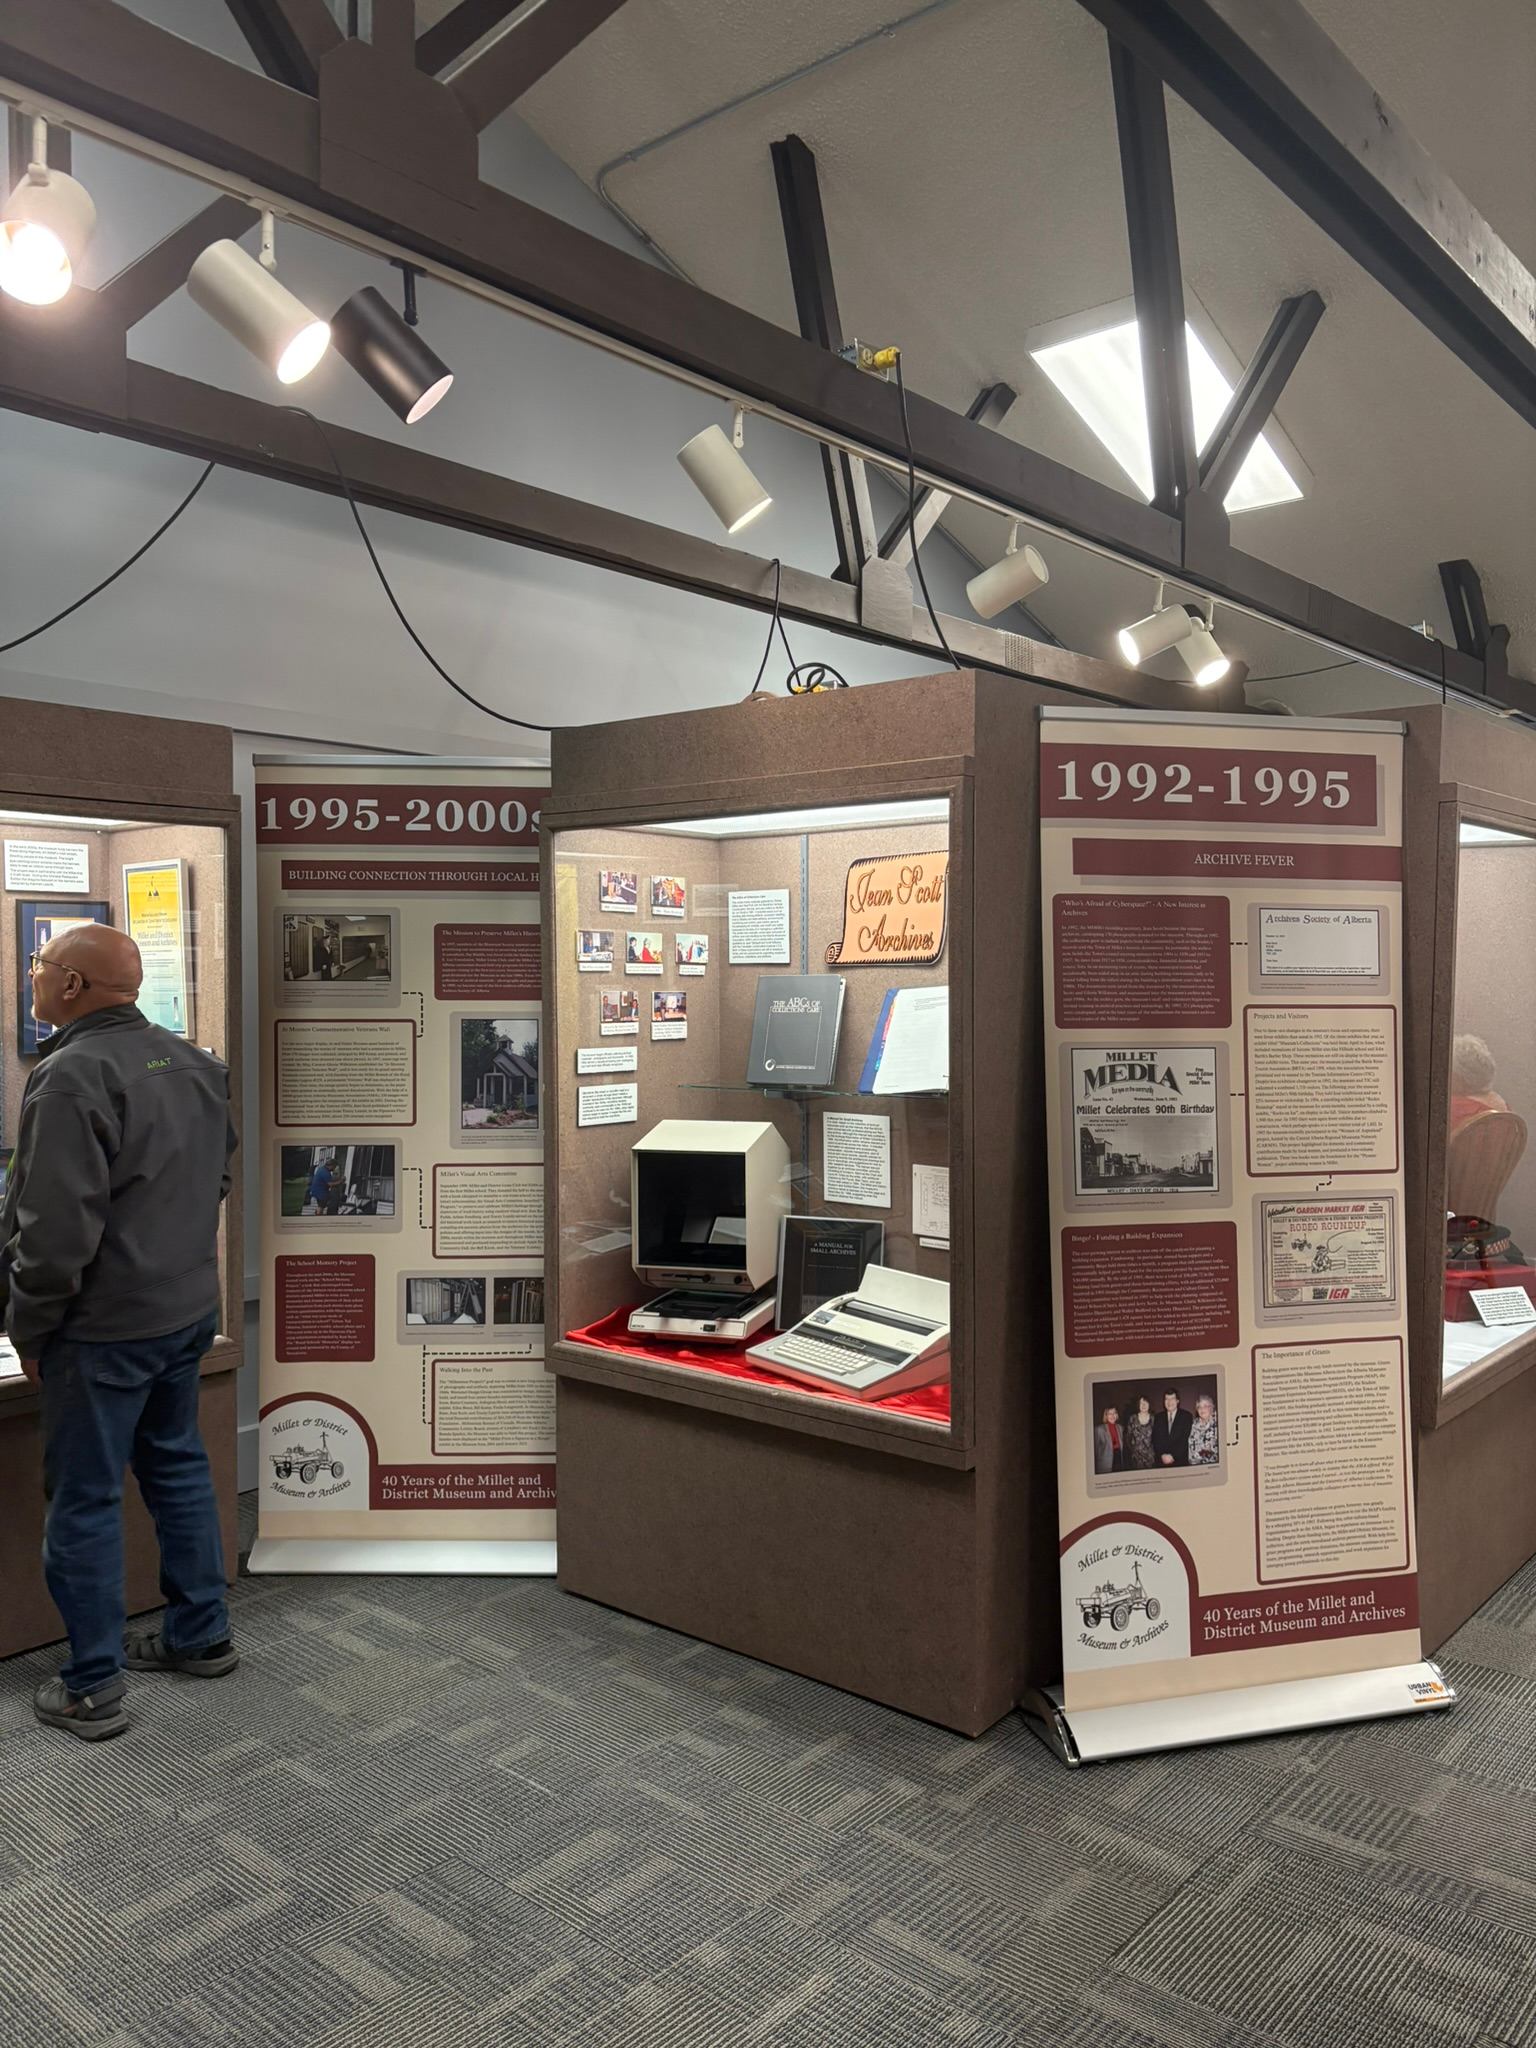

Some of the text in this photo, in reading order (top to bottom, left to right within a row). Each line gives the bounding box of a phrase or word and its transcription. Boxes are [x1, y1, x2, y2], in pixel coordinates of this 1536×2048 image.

[1058, 760, 1350, 808] 1992-1995
[260, 798, 541, 832] 1995-2000s
[1194, 854, 1294, 866] ARCHIVE FEVER
[289, 870, 347, 881] BUILDING
[350, 870, 427, 882] CONNECTION
[428, 872, 488, 882] THROUGH
[491, 872, 528, 882] LOCAL
[849, 864, 945, 912] Jean Scott
[1266, 914, 1300, 924] Archives
[1303, 914, 1332, 924] Society
[1342, 916, 1372, 924] Alberta
[858, 914, 935, 952] Archives
[787, 997, 810, 1008] ABCs
[146, 1057, 172, 1069] ARIAT
[1106, 1052, 1158, 1062] MILLET
[1083, 1063, 1183, 1099] MEDIA
[1076, 1104, 1214, 1115] Millet Celebrates 90th Birthday
[1290, 1221, 1367, 1232] RODEO ROUNDUP
[1152, 1232, 1183, 1240] Expansion
[1329, 1288, 1350, 1300] IGA
[1273, 1351, 1304, 1360] Importance
[272, 1418, 348, 1436] Millet & District
[382, 1475, 541, 1486] 40 Years of the Millet and
[270, 1479, 352, 1498] Museum & Archives
[382, 1487, 557, 1499] District Museum and Archiv
[1077, 1544, 1165, 1572] Millet & District
[1203, 1592, 1375, 1622] 40 Years of the Millet and
[1204, 1605, 1406, 1641] District Museum and Archives
[1077, 1618, 1170, 1651] Museum & Archives
